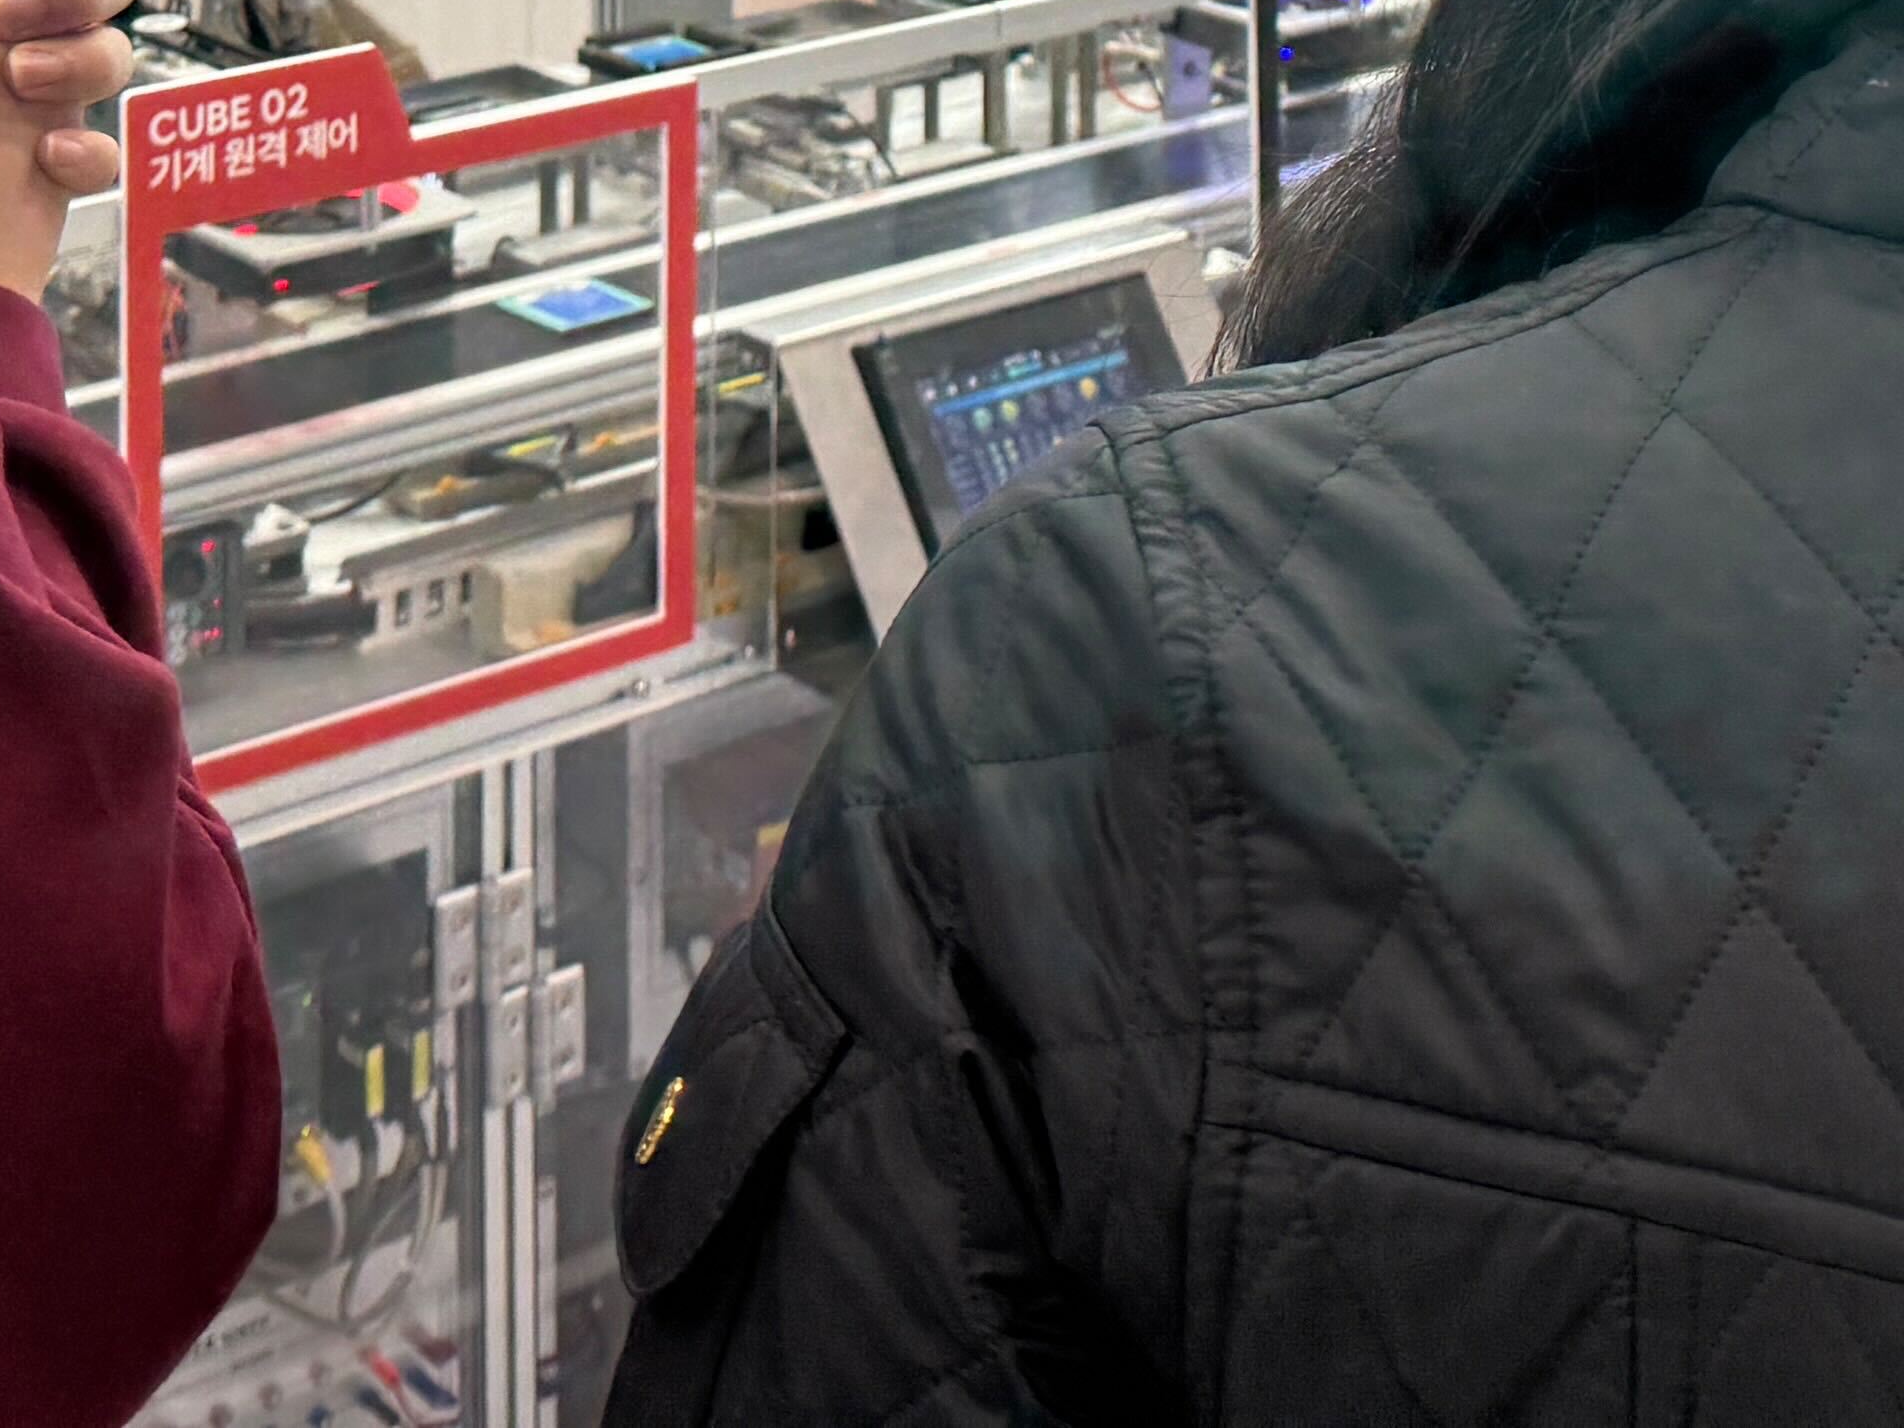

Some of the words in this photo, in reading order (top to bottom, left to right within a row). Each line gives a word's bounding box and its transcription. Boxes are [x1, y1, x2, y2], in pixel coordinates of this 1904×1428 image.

[148, 92, 253, 147] CUBE
[259, 82, 310, 125] 02
[147, 140, 217, 194] 기계
[223, 126, 289, 180] 원격
[294, 111, 359, 161] 제어
